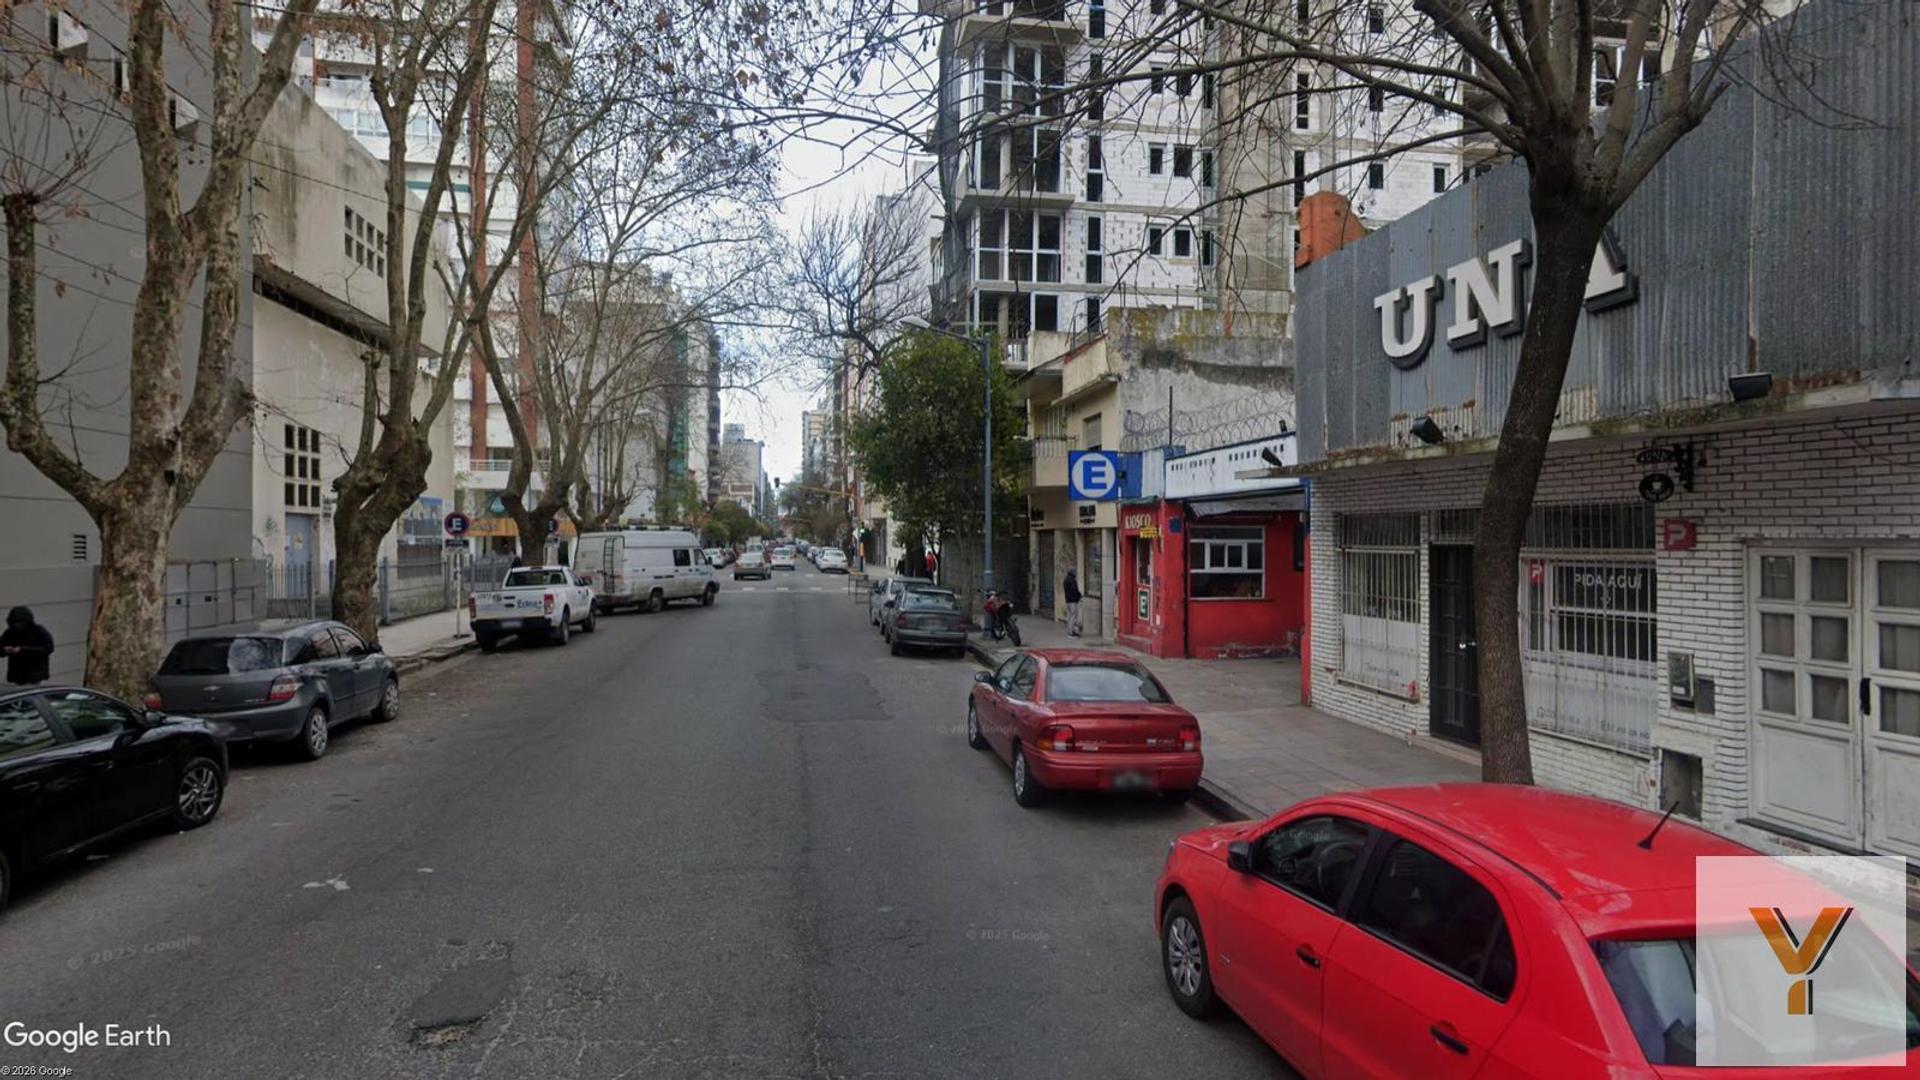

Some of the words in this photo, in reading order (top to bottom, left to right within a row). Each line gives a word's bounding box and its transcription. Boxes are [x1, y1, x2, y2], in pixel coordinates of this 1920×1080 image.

[1083, 460, 1107, 490] E
[452, 517, 463, 531] E
[1124, 512, 1152, 529] KIOSCO
[1667, 524, 1686, 545] P
[1574, 572, 1604, 587] PIDA
